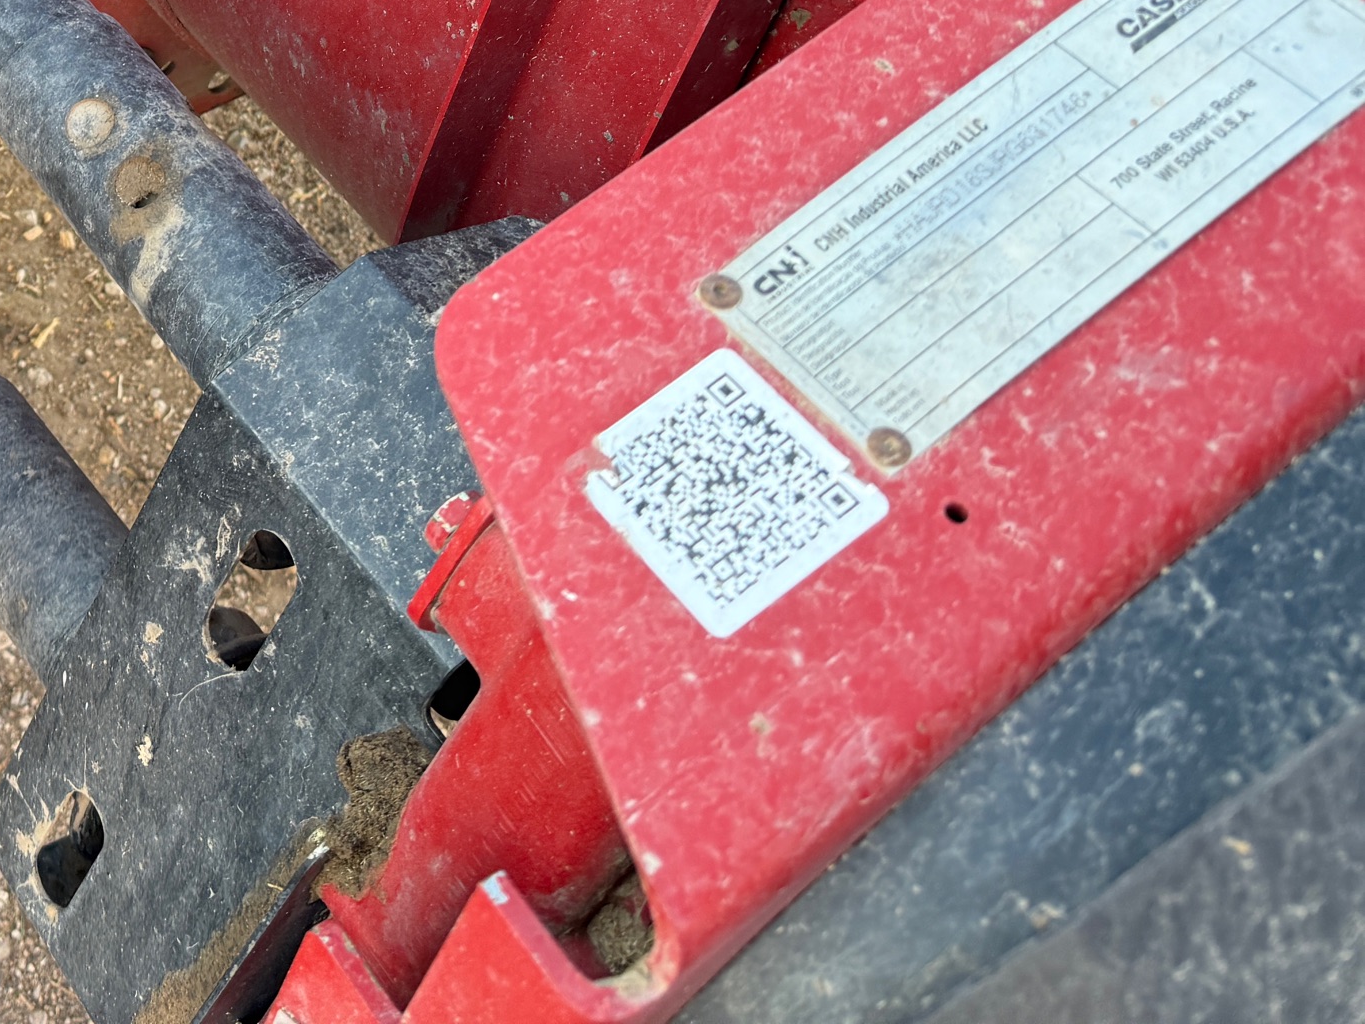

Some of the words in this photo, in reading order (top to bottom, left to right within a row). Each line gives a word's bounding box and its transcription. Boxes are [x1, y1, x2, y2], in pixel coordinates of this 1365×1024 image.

[813, 225, 849, 252] CNH
[843, 176, 910, 229] Industrial
[905, 139, 962, 184] America
[957, 117, 988, 143] LLC
[1110, 165, 1140, 189] 700
[1135, 141, 1173, 169] State
[1168, 110, 1216, 144] Street,
[1209, 78, 1257, 114] Racine
[1154, 163, 1179, 182] WI
[1173, 136, 1215, 169] 53404
[1211, 108, 1255, 139] U.S.A.
